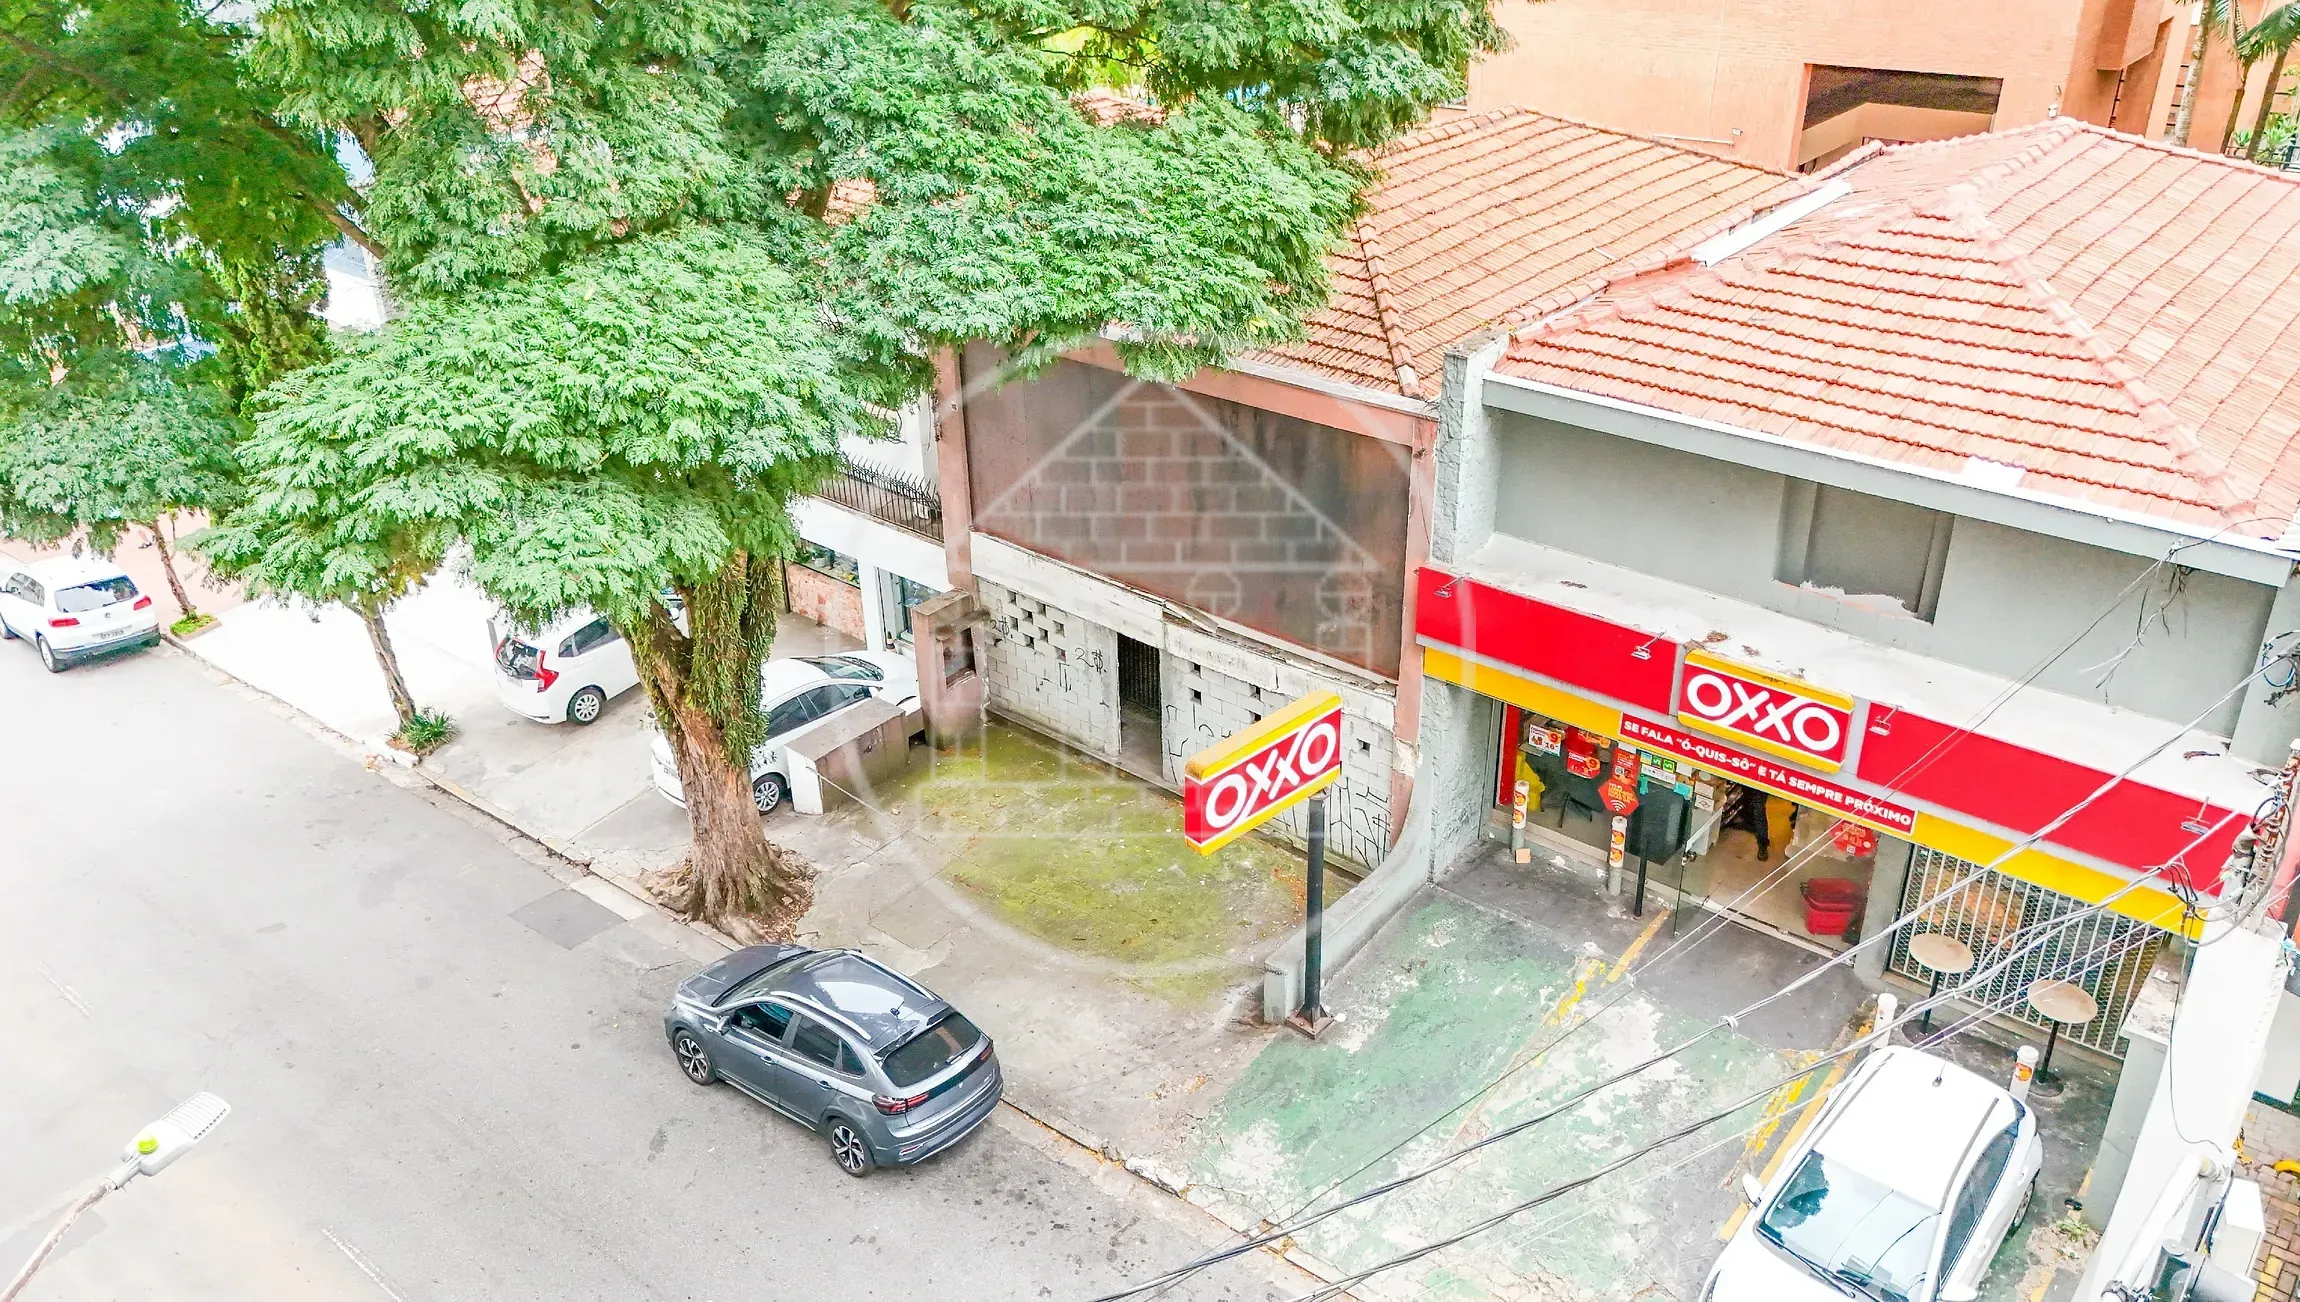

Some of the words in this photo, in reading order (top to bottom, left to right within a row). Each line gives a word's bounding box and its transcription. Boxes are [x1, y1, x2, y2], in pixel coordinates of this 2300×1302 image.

[1687, 673, 1840, 751] OXXO
[1205, 723, 1336, 828] OXXO
[1623, 720, 1640, 734] SE
[1641, 725, 1674, 746] FALA
[1757, 765, 1767, 777] E
[1769, 768, 1787, 785] TÁ
[1788, 776, 1843, 803] SEMPRE
[1844, 796, 1912, 826] PRÓXIMO
